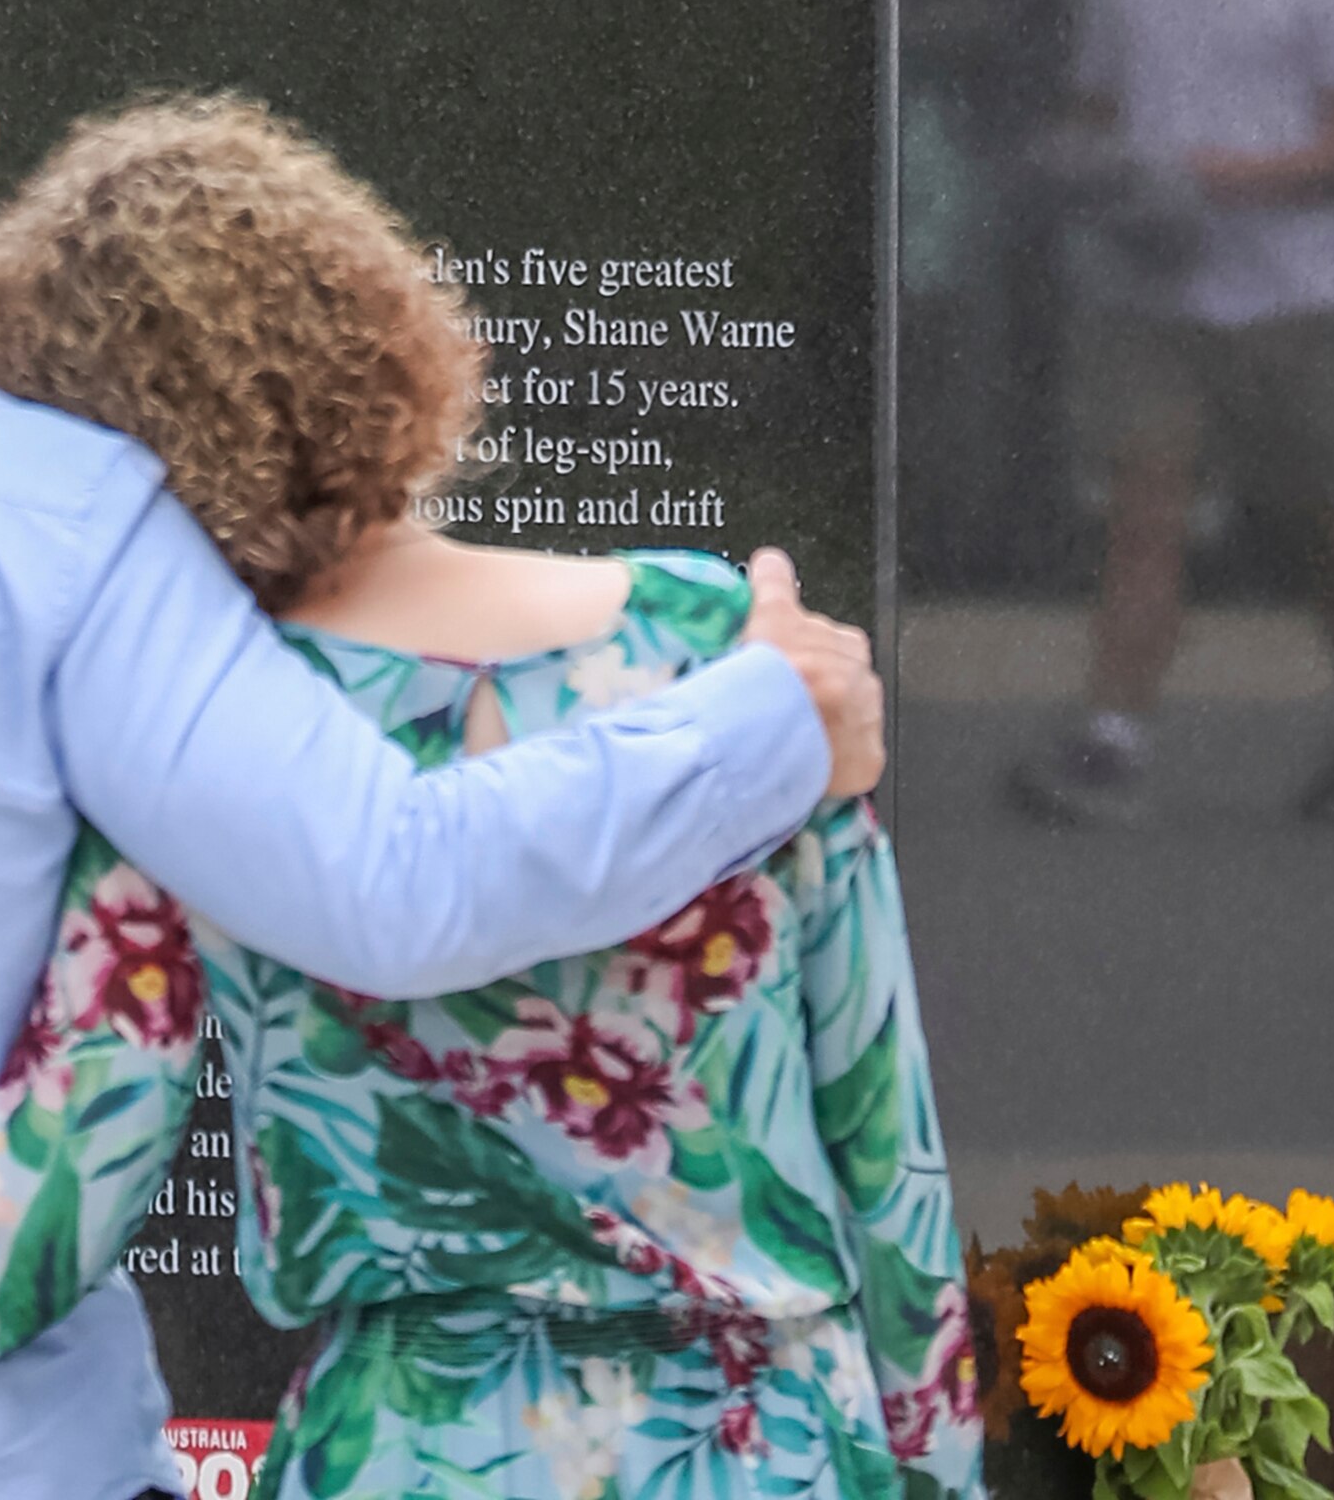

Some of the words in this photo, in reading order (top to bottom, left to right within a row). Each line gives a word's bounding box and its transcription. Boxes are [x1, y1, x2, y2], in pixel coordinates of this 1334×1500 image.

[430, 247, 510, 286] den's
[521, 247, 588, 287] five
[599, 254, 734, 297] greatest
[563, 308, 669, 348] Shane
[680, 309, 795, 349] Warne
[522, 367, 575, 405] for
[587, 369, 627, 405] 15
[637, 376, 740, 416] years.
[477, 425, 516, 463] of
[524, 427, 673, 476] leg-spin,
[494, 486, 566, 534] spin
[576, 488, 639, 526] and
[649, 488, 726, 528] drift
[186, 1179, 236, 1217] his
[190, 1245, 220, 1276] at
